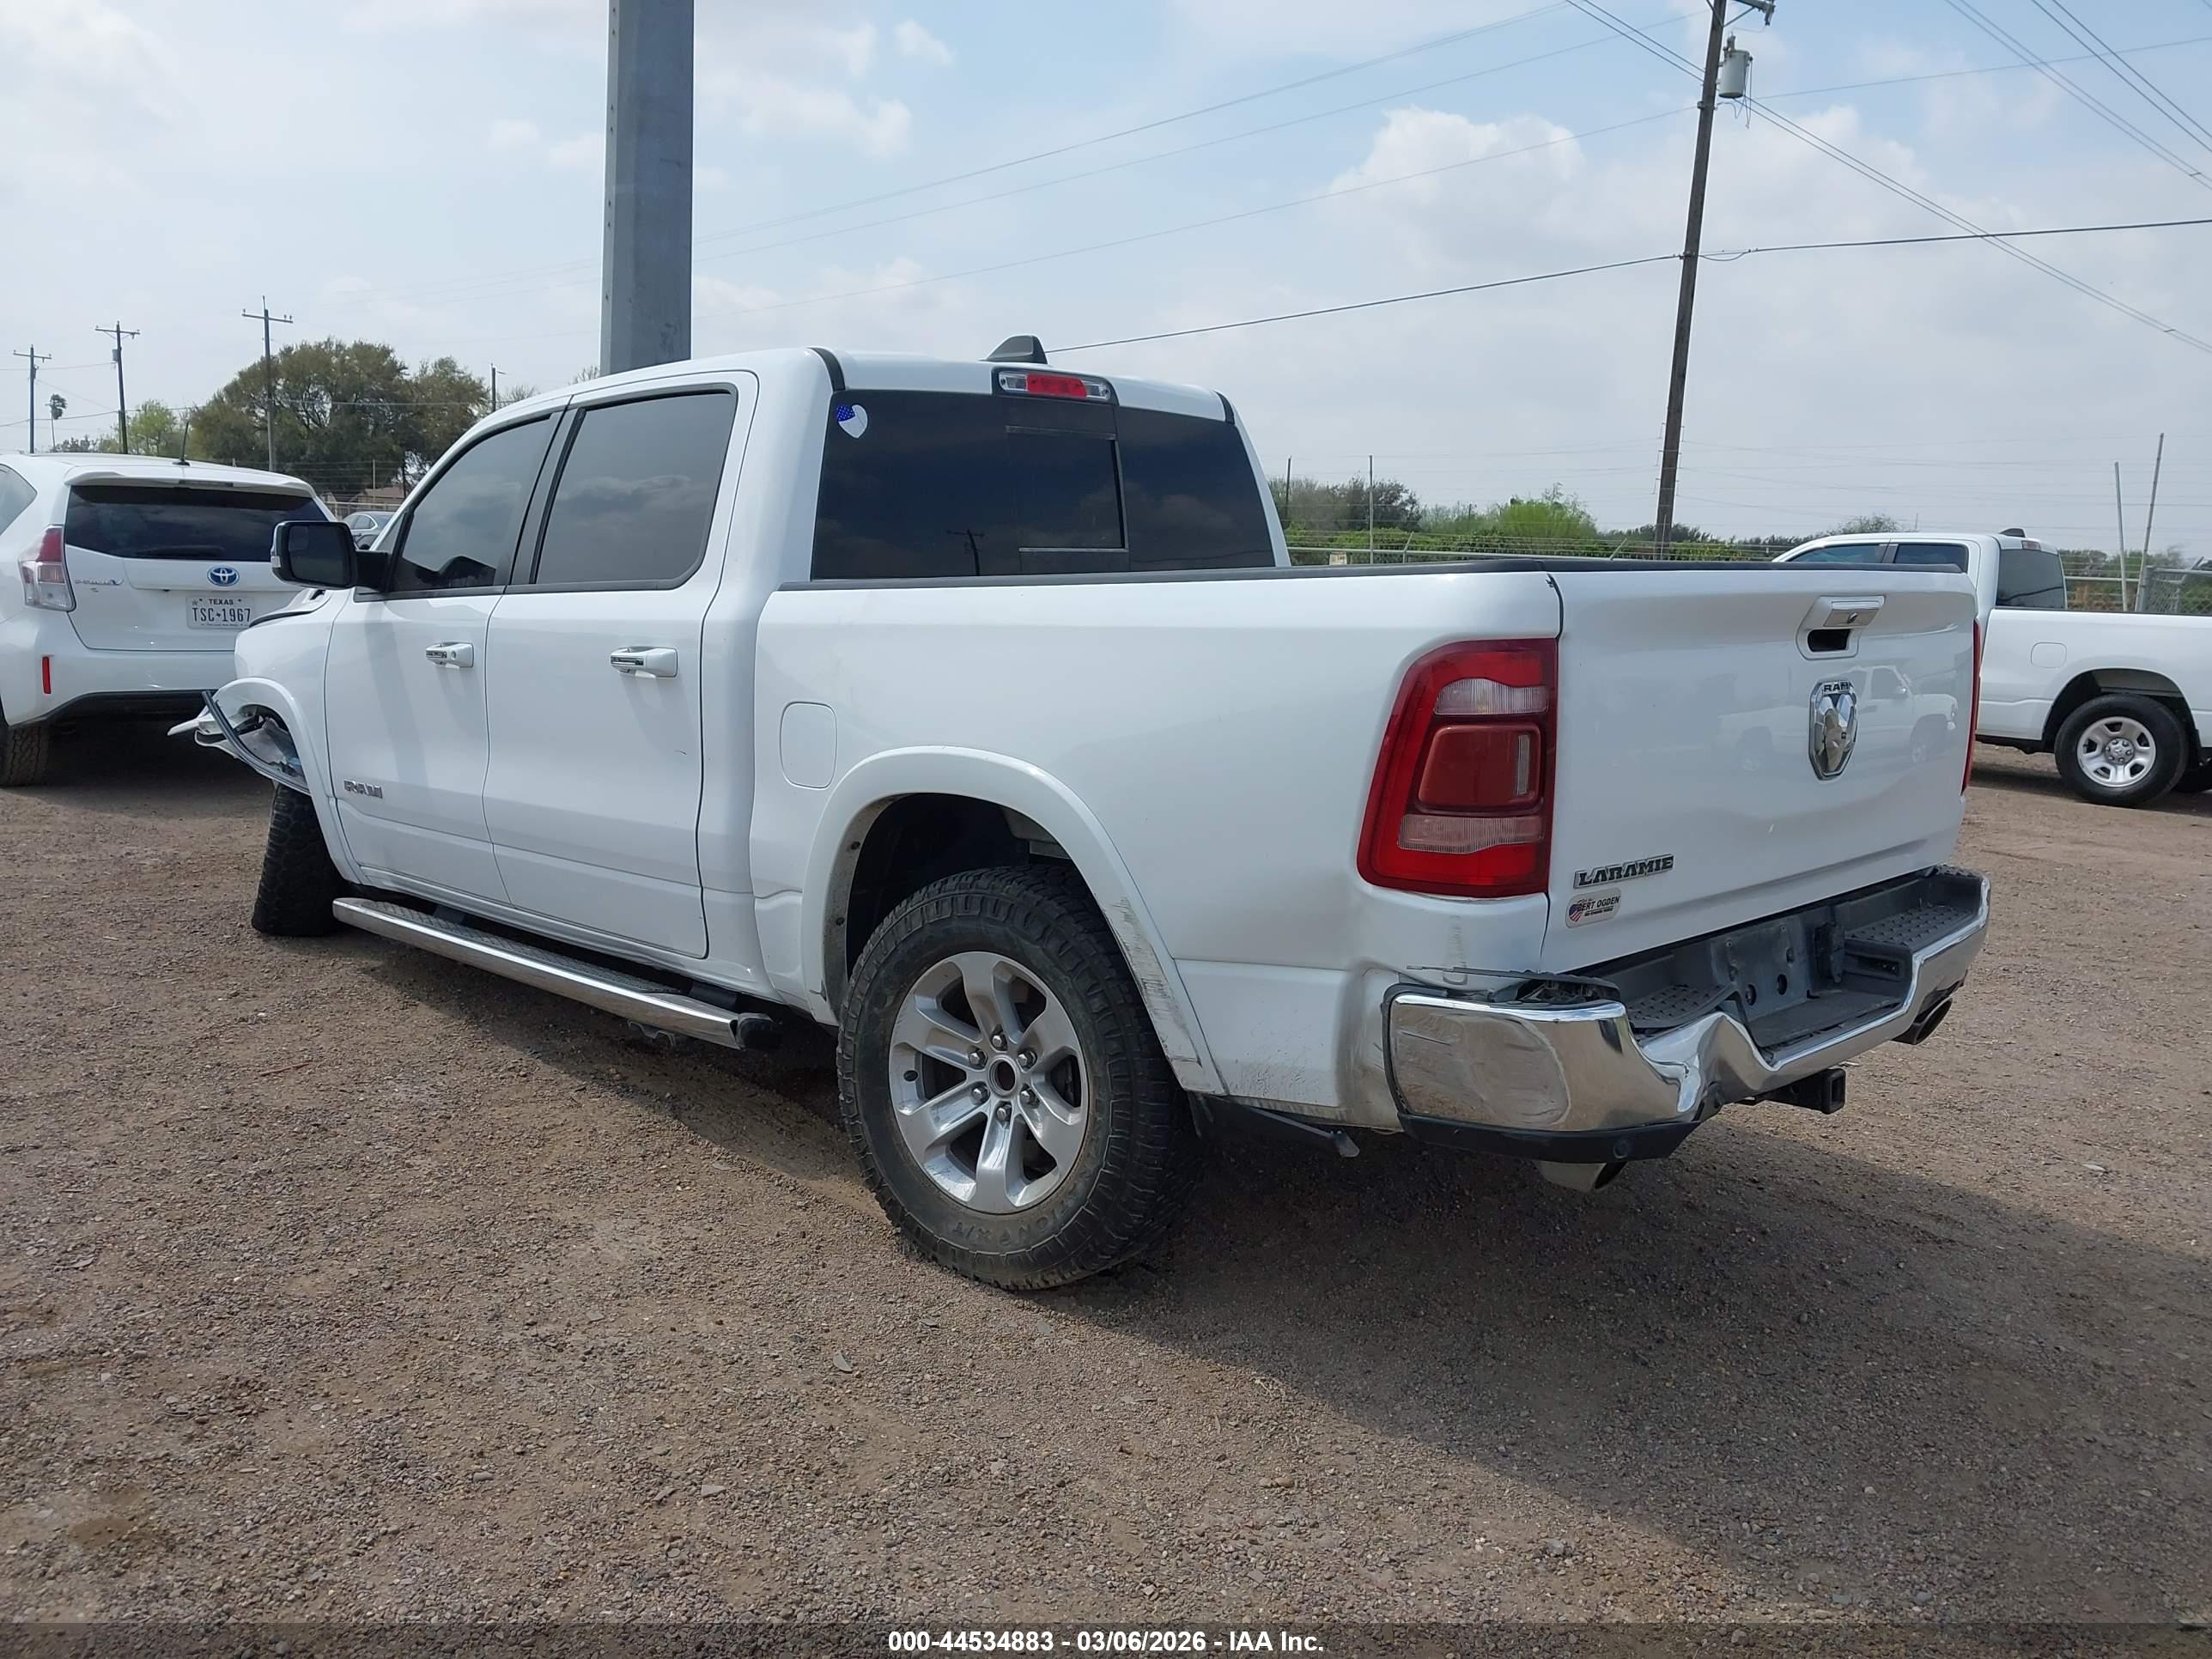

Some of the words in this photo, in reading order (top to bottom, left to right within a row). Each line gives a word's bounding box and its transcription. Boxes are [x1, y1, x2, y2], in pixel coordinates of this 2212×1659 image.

[1823, 681, 1850, 693] RAM
[343, 779, 384, 799] RAM
[1575, 854, 1674, 888] LARAMIE
[1596, 895, 1620, 908] OGDEN
